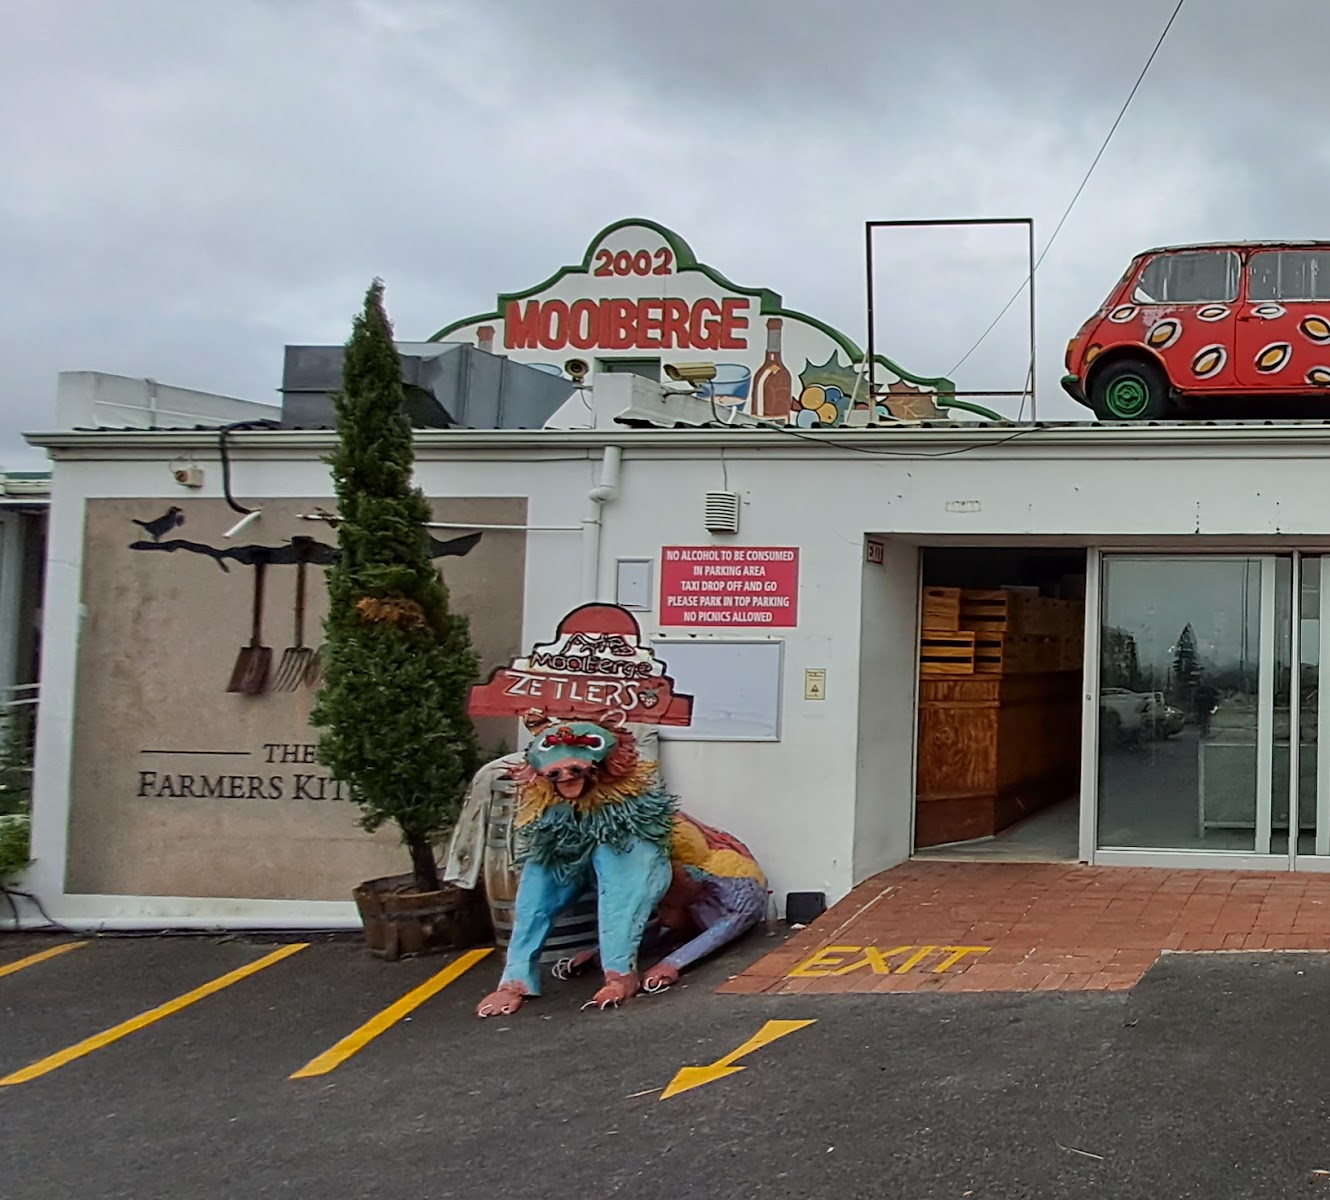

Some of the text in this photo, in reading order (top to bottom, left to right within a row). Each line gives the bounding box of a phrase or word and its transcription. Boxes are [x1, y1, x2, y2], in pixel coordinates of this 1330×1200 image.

[594, 246, 673, 277] 2002
[504, 297, 750, 350] MOOIBERGE
[667, 551, 794, 561] NO ALCOHOL TO BE CONSUMED
[693, 566, 766, 576] IN PARKING AREA
[680, 581, 777, 591] TAXI DROP OFF AND GO
[667, 596, 789, 607] PLEASE PARK IN TOP PARKING
[683, 611, 772, 622] NO PICNICS ALLOWED
[263, 743, 316, 763] THE
[137, 771, 283, 799] FARMERS
[786, 945, 992, 977] EXIT
